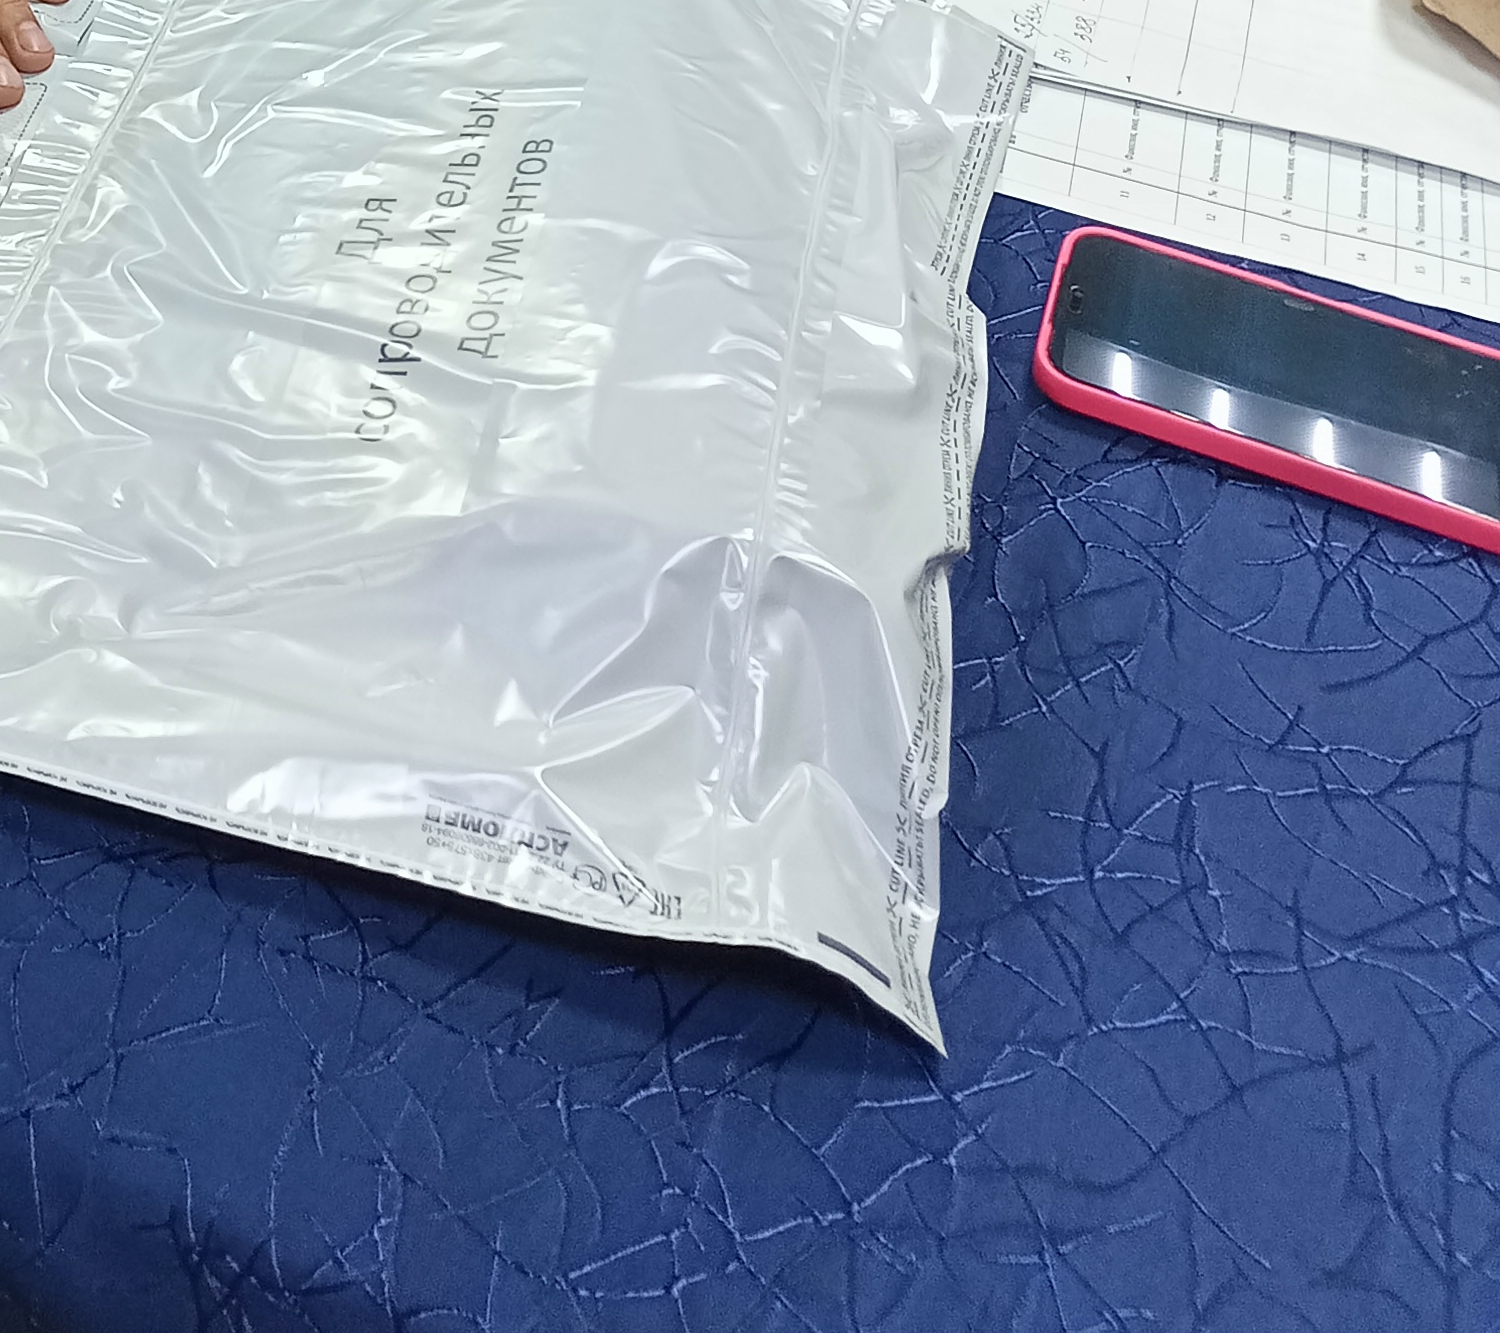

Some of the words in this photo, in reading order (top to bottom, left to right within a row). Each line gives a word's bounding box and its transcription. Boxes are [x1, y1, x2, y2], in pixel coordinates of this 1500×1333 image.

[1119, 190, 1130, 199] 11
[1205, 213, 1217, 222] 12
[335, 197, 398, 265] Для
[1279, 233, 1291, 242] 13
[457, 138, 555, 360] документов
[1356, 252, 1367, 262] 14
[1414, 265, 1426, 275] 15
[1459, 276, 1471, 286] 16
